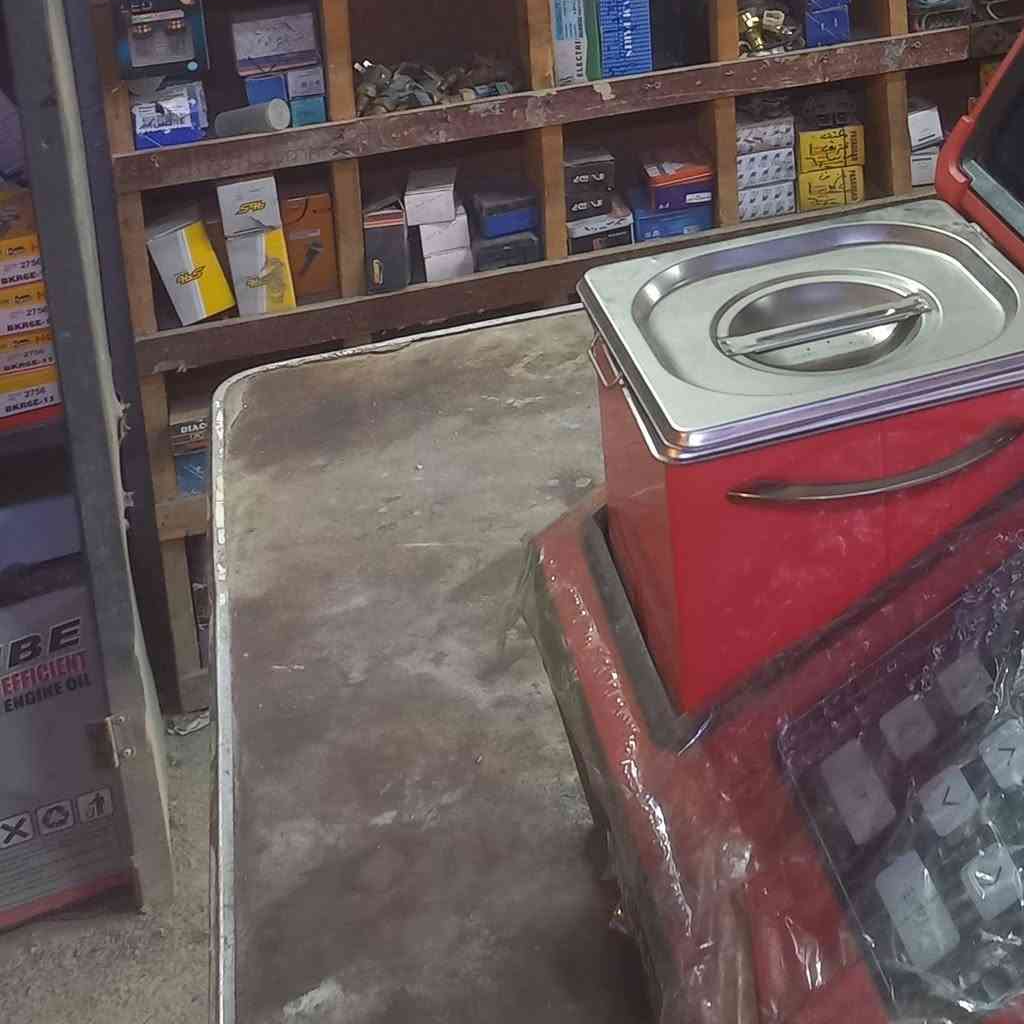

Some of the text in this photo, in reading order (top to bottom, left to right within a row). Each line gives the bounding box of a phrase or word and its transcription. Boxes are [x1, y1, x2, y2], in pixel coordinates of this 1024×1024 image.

[574, 40, 583, 78] ELECTRI
[0, 616, 81, 669] BE
[0, 652, 88, 697] EFFICIENT
[4, 674, 92, 713] ENGINE OIL
